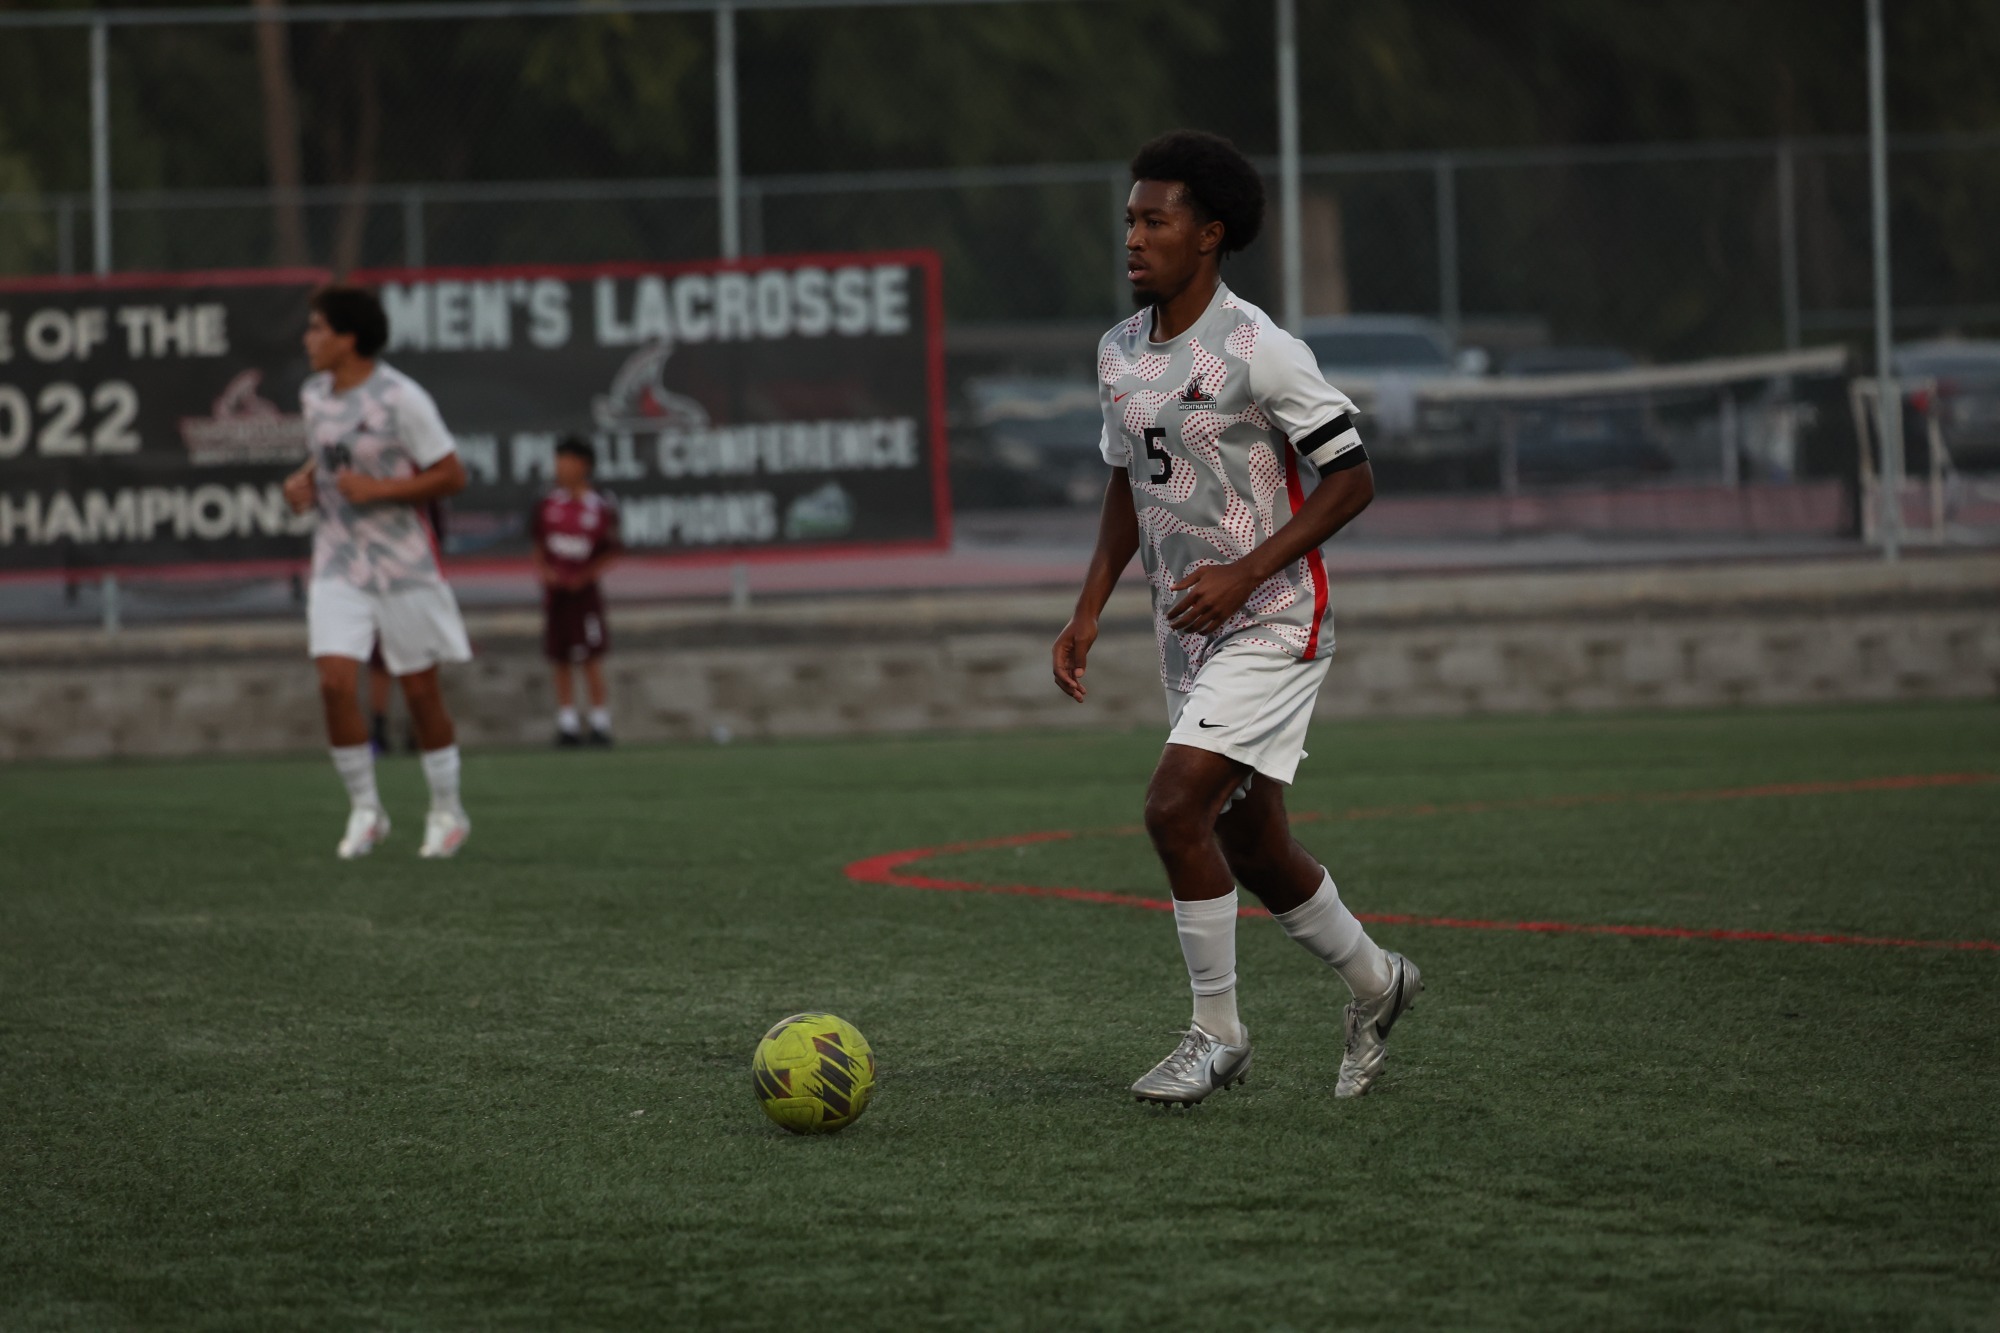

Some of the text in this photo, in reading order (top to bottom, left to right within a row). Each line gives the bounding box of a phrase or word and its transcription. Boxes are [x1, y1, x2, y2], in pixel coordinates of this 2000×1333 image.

[25, 307, 107, 363] OF
[119, 304, 228, 357] THE
[382, 264, 909, 353] MEN'S LACROSSE
[657, 418, 917, 478] CONFERENCE
[1143, 427, 1173, 485] 5
